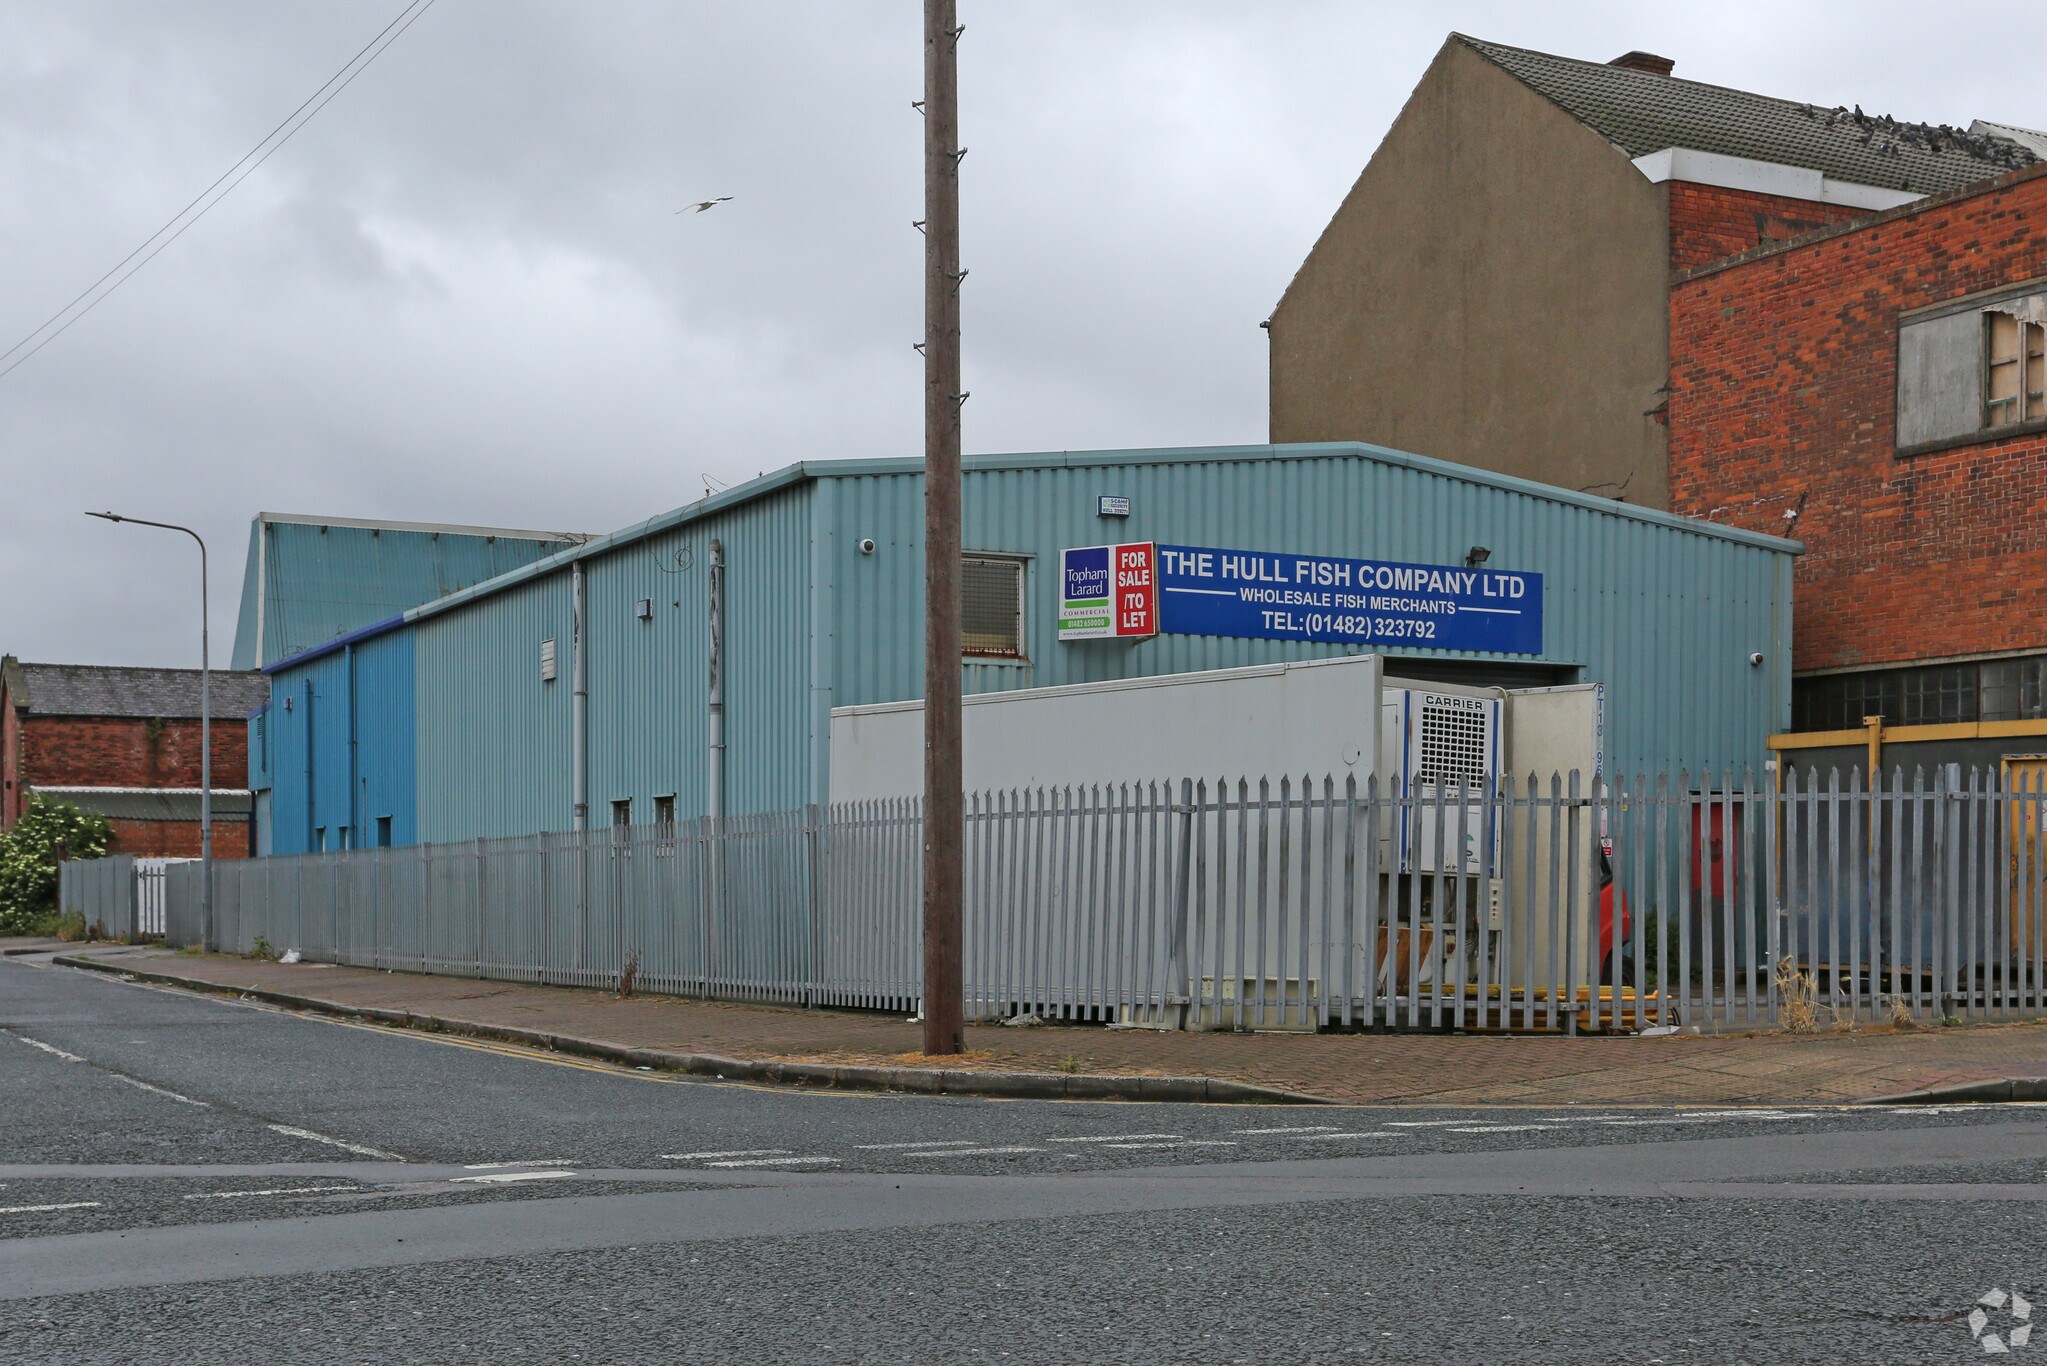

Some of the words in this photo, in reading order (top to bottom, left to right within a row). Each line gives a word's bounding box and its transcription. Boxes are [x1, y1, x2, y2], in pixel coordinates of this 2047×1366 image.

[1121, 551, 1146, 569] FOR
[1066, 567, 1108, 584] Topham
[1118, 569, 1150, 587] SALE
[1161, 550, 1214, 578] THE
[1221, 555, 1289, 583] HULL
[1296, 560, 1351, 587] FISH
[1358, 565, 1477, 595] COMPANY
[1483, 574, 1525, 599] LTD
[1071, 580, 1103, 596] Larard
[1124, 593, 1144, 610] /TO
[1239, 587, 1331, 607] WHOLESALE
[1335, 594, 1366, 609] FISH
[1370, 596, 1456, 615] MERCHANTS
[1123, 611, 1147, 628] LET
[1374, 618, 1436, 639] 323792
[1426, 695, 1483, 710] CARRIER
